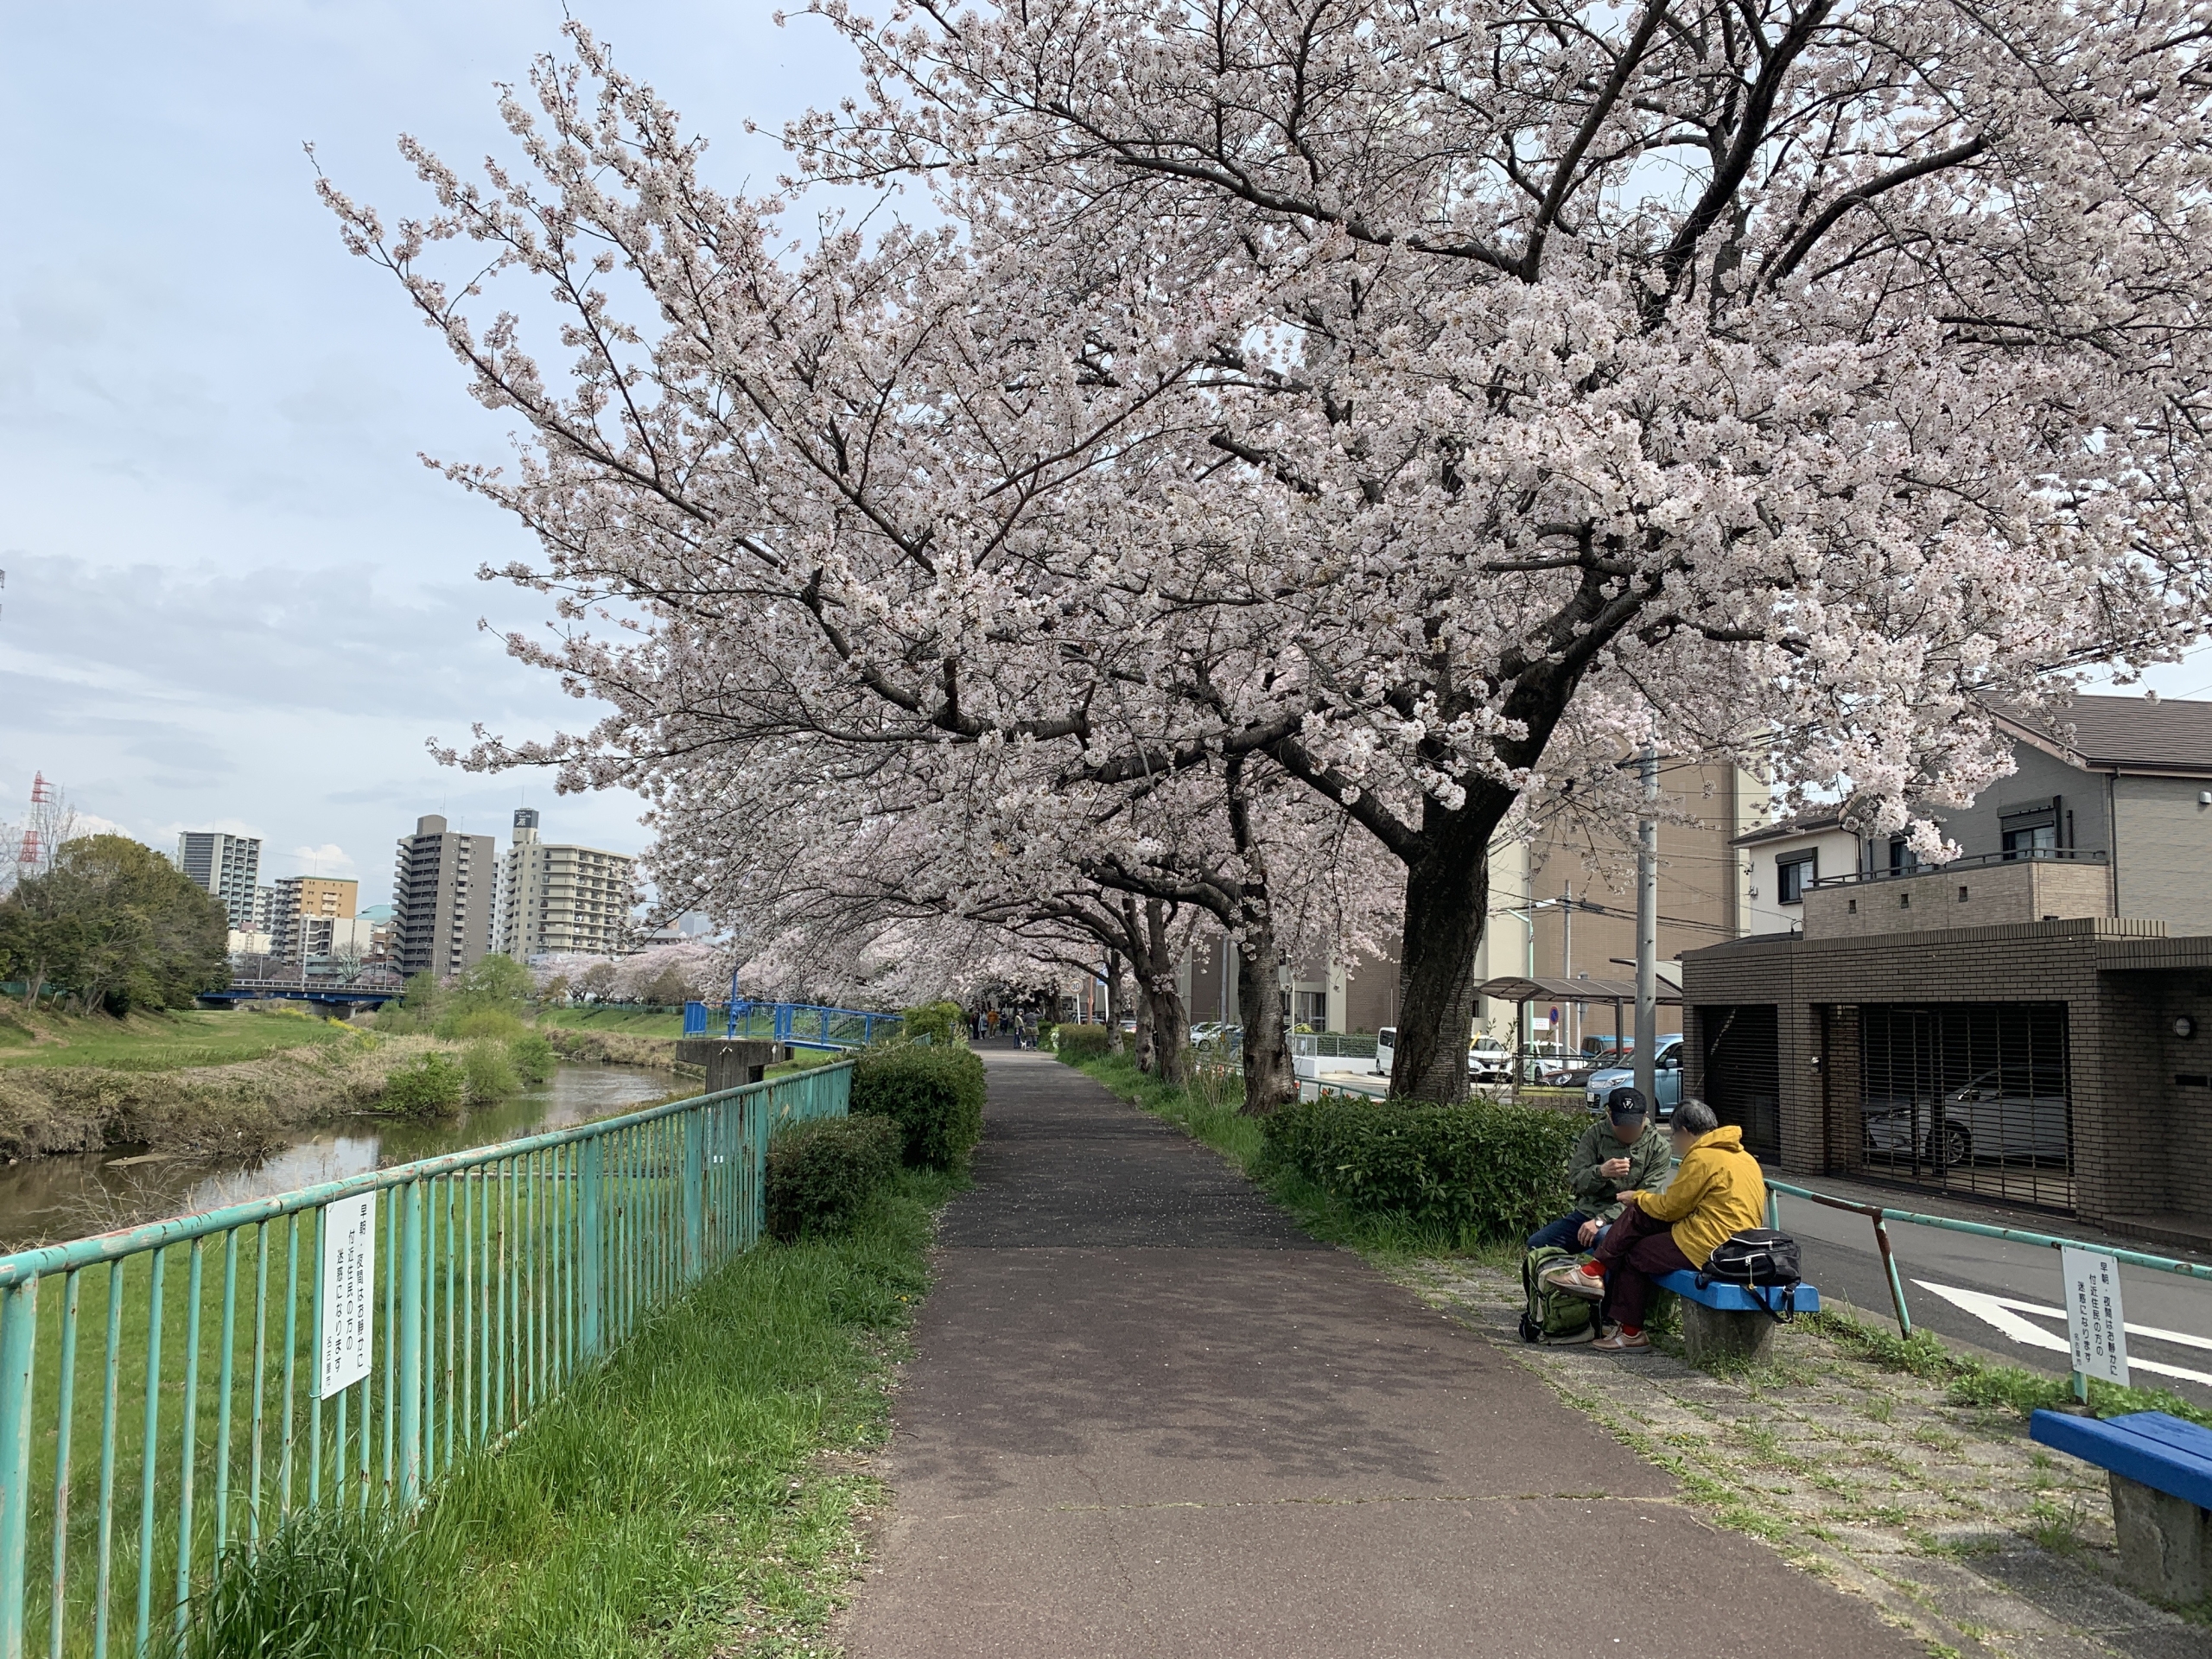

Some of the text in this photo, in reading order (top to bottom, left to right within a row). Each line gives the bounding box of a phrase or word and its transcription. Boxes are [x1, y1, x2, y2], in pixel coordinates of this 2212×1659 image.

[335, 1248, 344, 1372] 迷惑になります
[346, 1229, 355, 1351] 付近住民の方の
[2077, 1281, 2091, 1363] 迷惑になります
[2089, 1274, 2103, 1356] 付近住民の方の
[2101, 1262, 2118, 1376] 早朝・夜間はお静かに
